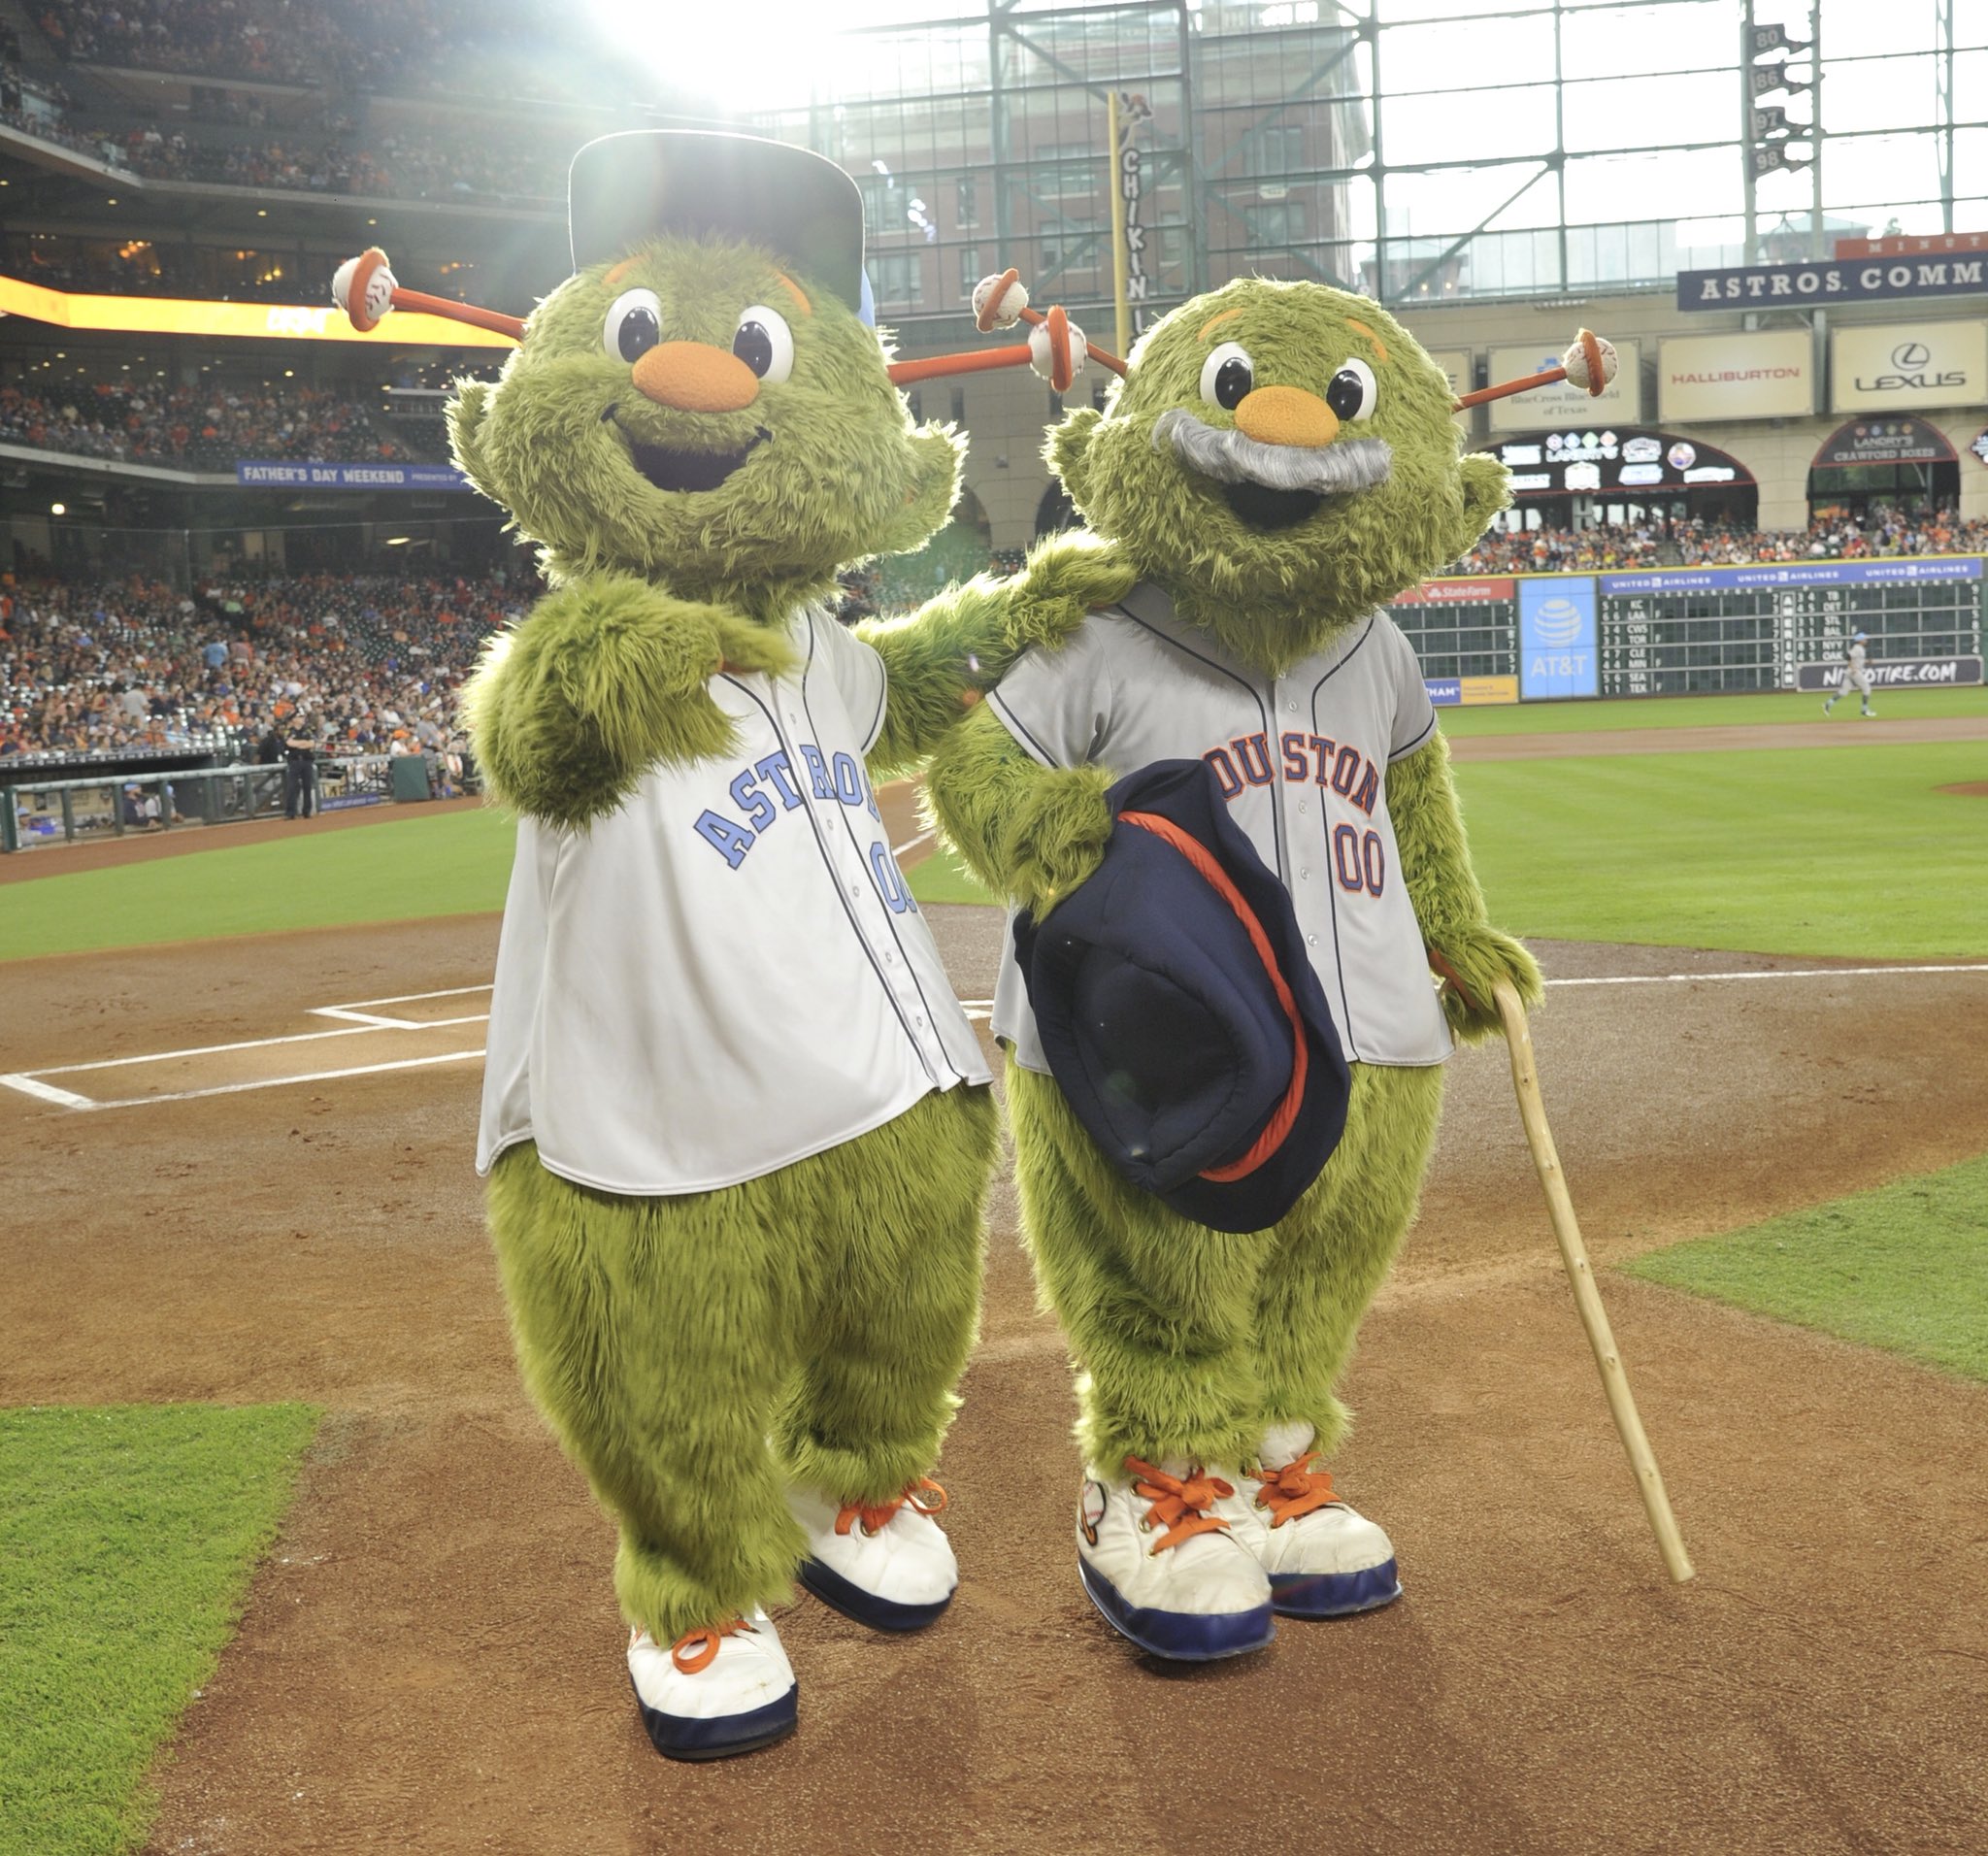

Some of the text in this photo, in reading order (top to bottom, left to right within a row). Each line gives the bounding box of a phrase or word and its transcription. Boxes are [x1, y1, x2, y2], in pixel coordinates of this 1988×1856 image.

[1756, 30, 1778, 48] 80
[1756, 71, 1778, 88] 86
[1756, 113, 1777, 129] 97
[1756, 151, 1779, 169] 98
[1123, 149, 1146, 299] CHIKIN
[1870, 237, 1980, 252] MINUT
[1861, 261, 1987, 289] COMM
[1672, 368, 1800, 384] HALLIBURTON
[1856, 372, 1966, 391] LEXUS
[1558, 406, 1586, 414] Texas
[1854, 437, 1913, 447] LANDRY'S
[1835, 448, 1935, 461] CRAWFORD BOXES
[245, 467, 307, 481] FATHER'S
[313, 469, 337, 481] DAY
[343, 470, 404, 483] WEEKEND
[1790, 571, 1839, 580] AIRLINES
[1866, 566, 1969, 577] UNITED AIRLINES
[1664, 577, 1710, 586] AIRLINES
[1827, 591, 1839, 601] TB
[1631, 600, 1643, 610] KC
[1824, 602, 1840, 612] DET
[1628, 611, 1645, 620] LAA
[1825, 615, 1840, 625] STL
[1627, 624, 1647, 634] CWS
[1824, 626, 1840, 636] BAL
[1629, 635, 1646, 644] TOR
[1783, 596, 1794, 684] AMERICAN
[1823, 641, 1843, 650] NYY
[1630, 648, 1645, 657] CLE
[1823, 651, 1843, 660] OAK
[1531, 654, 1587, 677] AT&T
[1629, 659, 1646, 668] MIN
[1630, 673, 1645, 681] SEA
[1823, 662, 1957, 686] NIOTIRE.COM
[1630, 683, 1646, 693] TEX
[1203, 732, 1379, 818] OUSTON
[1334, 822, 1386, 899] 00
